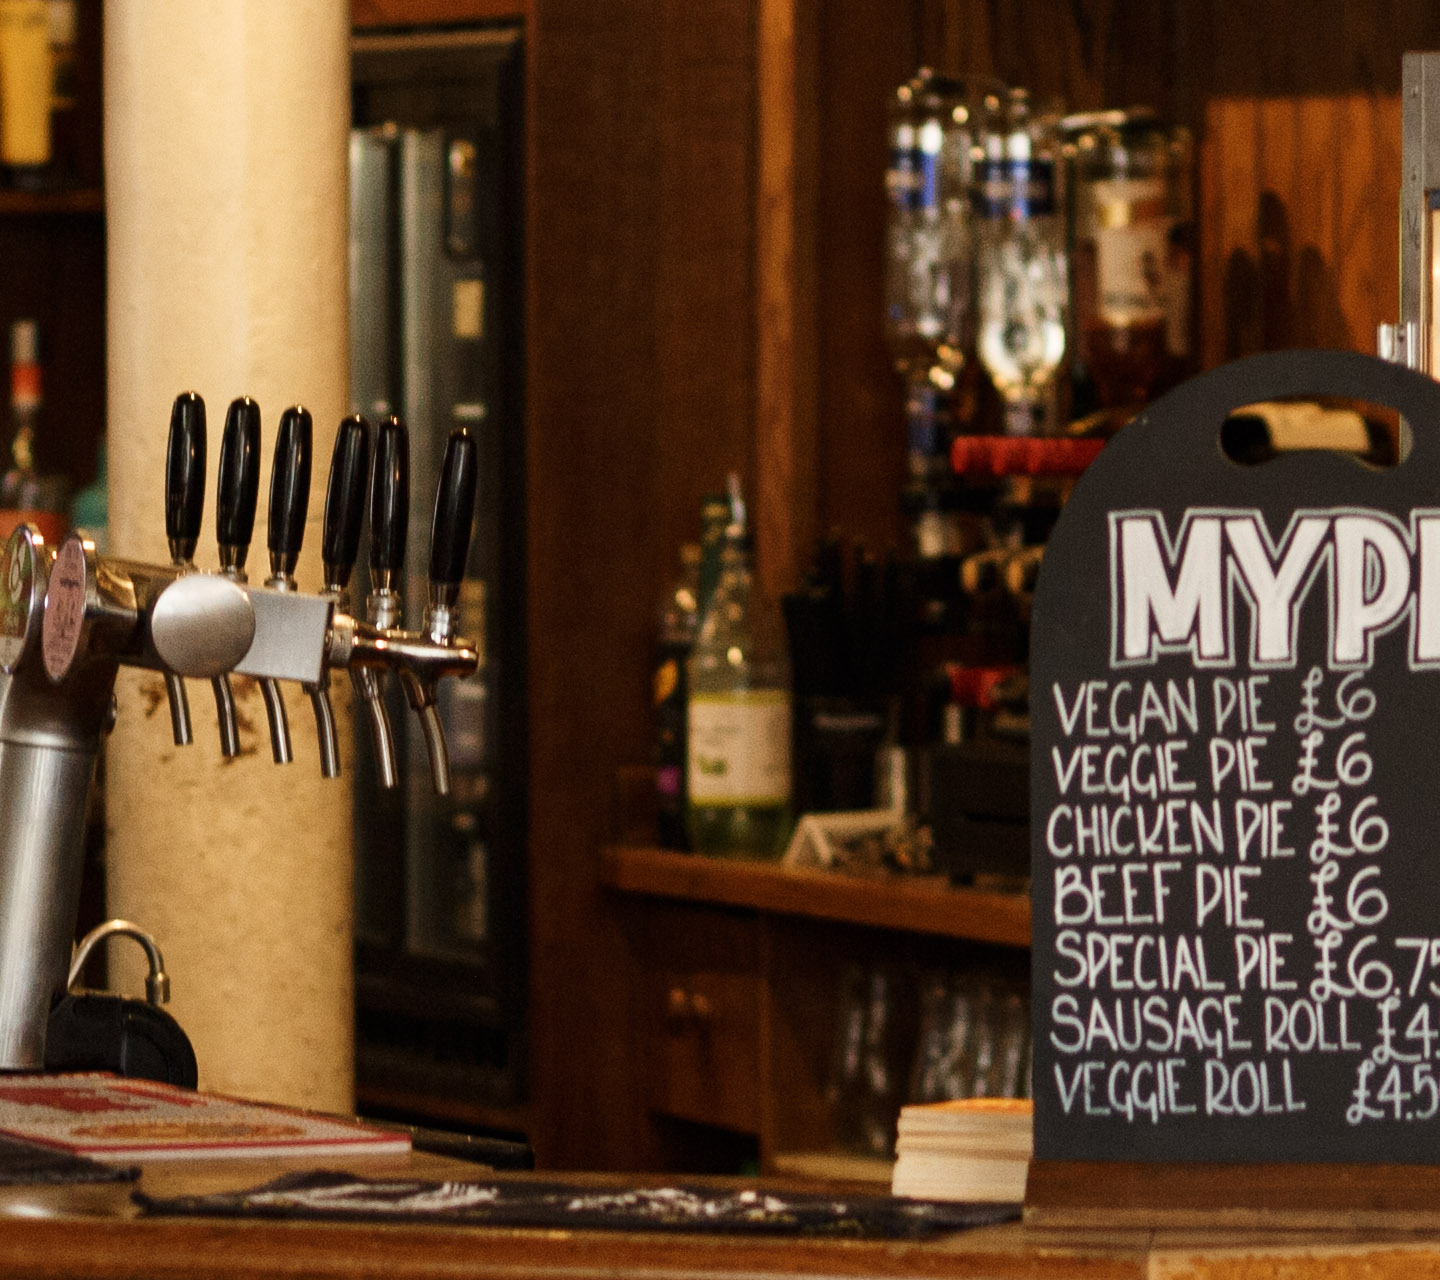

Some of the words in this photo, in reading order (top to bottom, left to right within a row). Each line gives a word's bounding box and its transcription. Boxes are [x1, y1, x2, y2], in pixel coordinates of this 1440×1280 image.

[1052, 678, 1199, 744] VEGAN
[1213, 675, 1276, 733] PIE
[1293, 666, 1377, 735] £6
[1052, 739, 1196, 802] VEGGIE
[1209, 737, 1274, 794] PIE
[1291, 732, 1373, 796] £6
[1046, 800, 1222, 858] CHICKEN
[1236, 801, 1296, 860] PIE
[1310, 792, 1390, 865] £6
[1053, 863, 1182, 926] BEEF
[1196, 865, 1265, 929] PIE
[1307, 860, 1389, 935] £6
[1053, 929, 1225, 991] SPECIAL
[1238, 933, 1298, 991] PIE
[1049, 994, 1252, 1061] SAUSAGE
[1265, 996, 1361, 1053] ROLL
[1053, 1061, 1197, 1124] VEGGIE
[1206, 1060, 1306, 1116] ROLL
